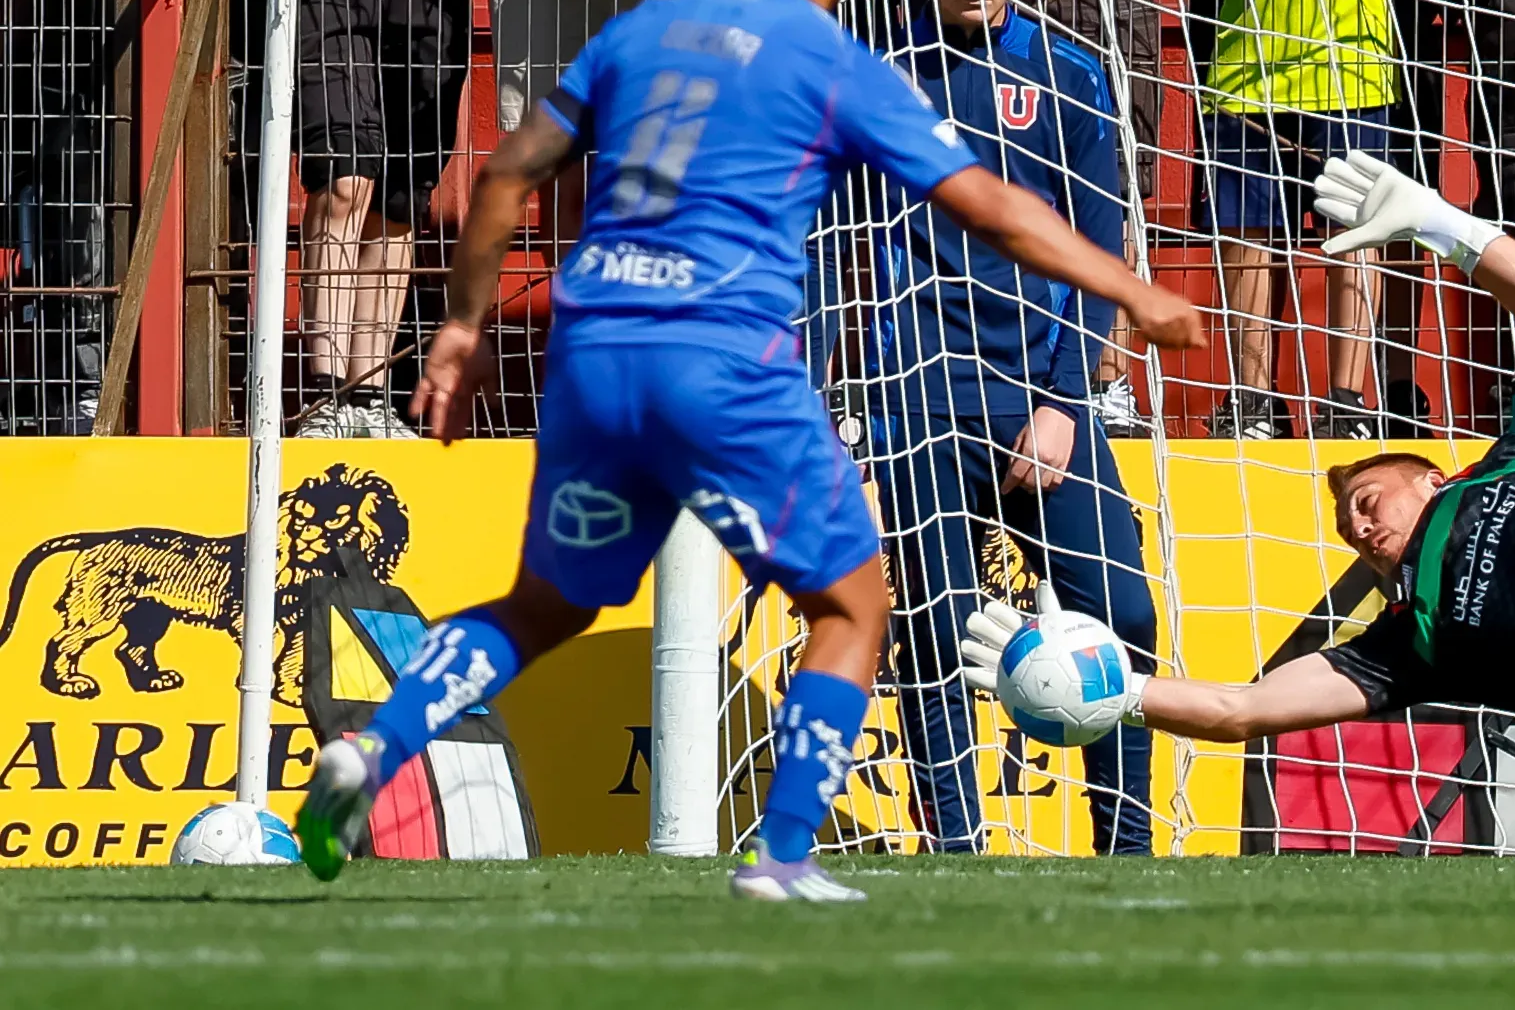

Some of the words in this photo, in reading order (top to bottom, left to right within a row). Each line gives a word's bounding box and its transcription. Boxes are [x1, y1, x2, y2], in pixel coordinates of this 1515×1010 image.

[997, 83, 1040, 130] U
[1468, 578, 1490, 628] BANK
[1479, 548, 1497, 574] OF
[0, 721, 320, 791] ARLE
[0, 822, 167, 858] COFF
